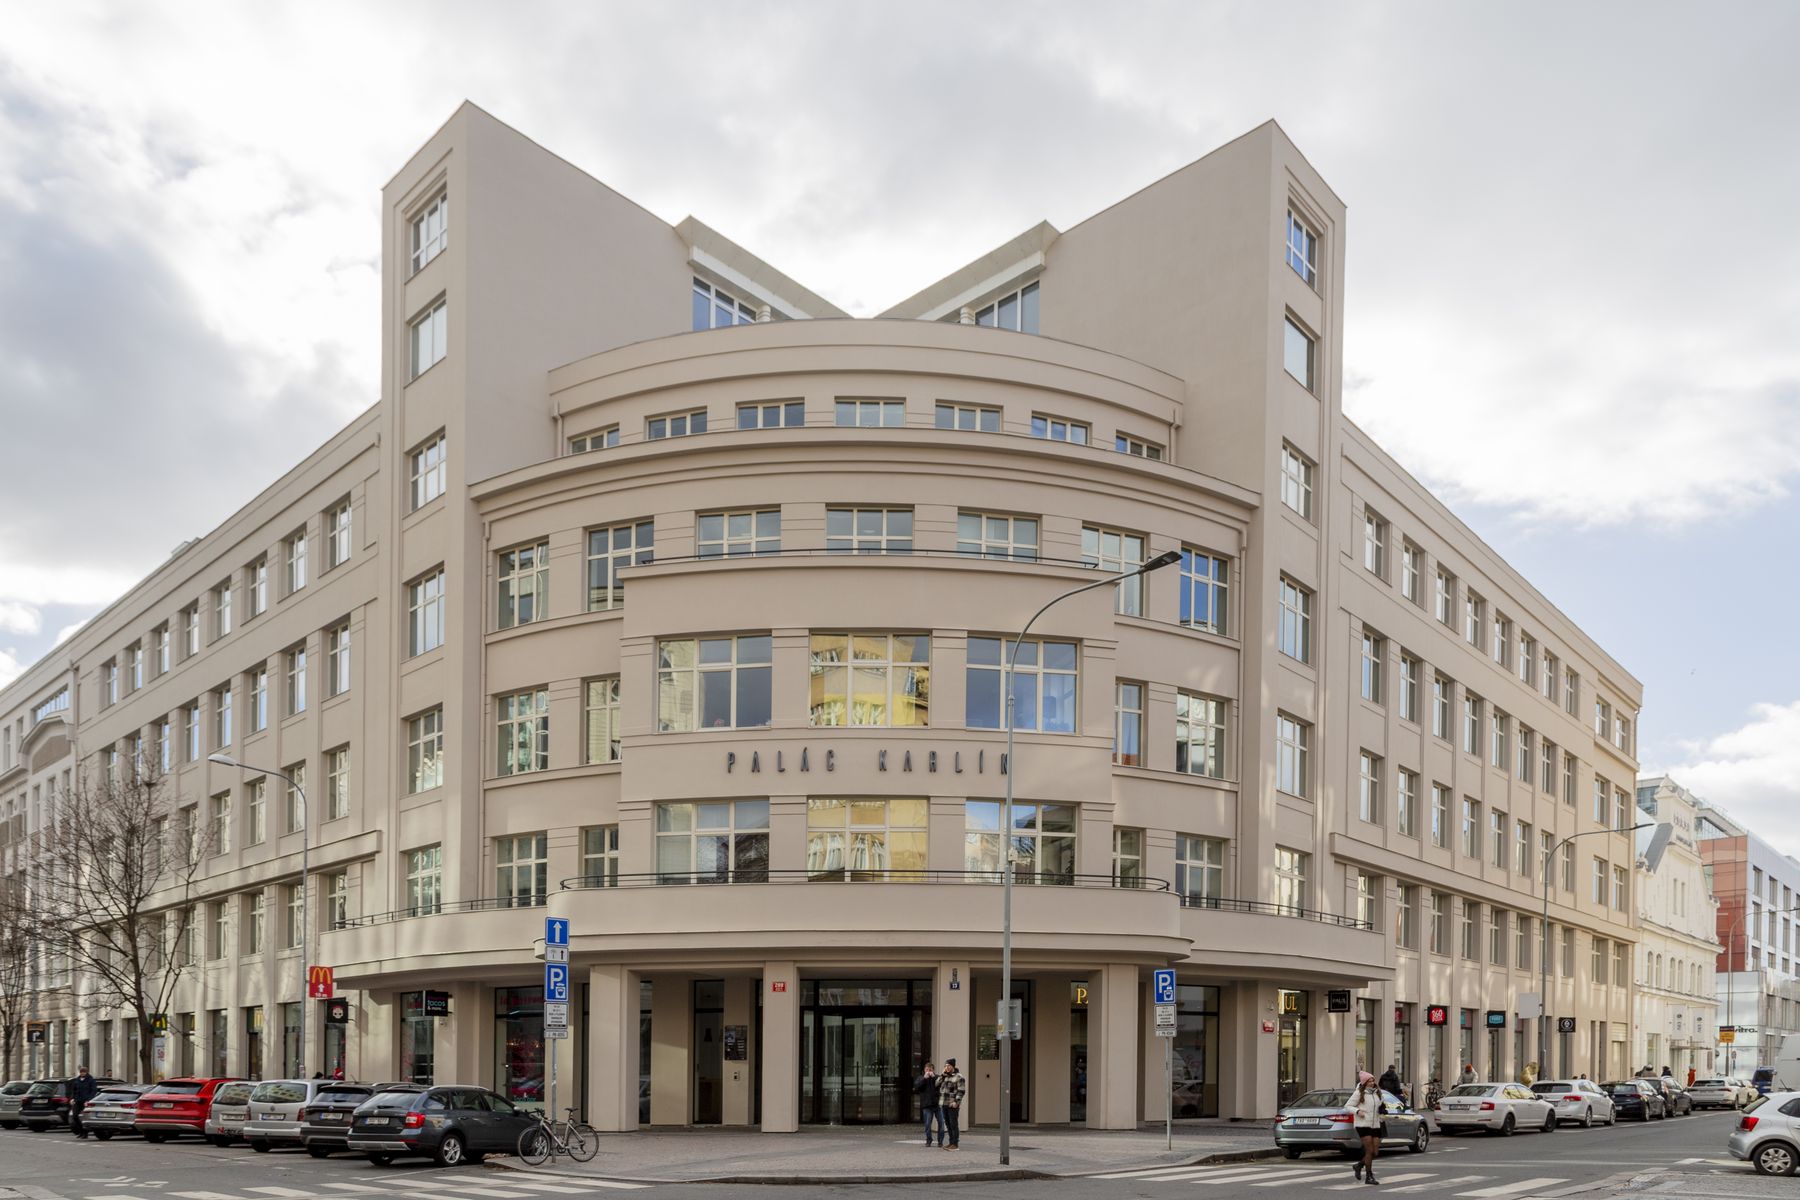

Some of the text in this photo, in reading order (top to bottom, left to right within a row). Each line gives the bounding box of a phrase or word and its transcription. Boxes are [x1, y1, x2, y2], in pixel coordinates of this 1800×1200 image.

[728, 747, 1008, 775] PALÁC KARLÍN
[550, 968, 563, 990] P
[1158, 974, 1171, 993] P
